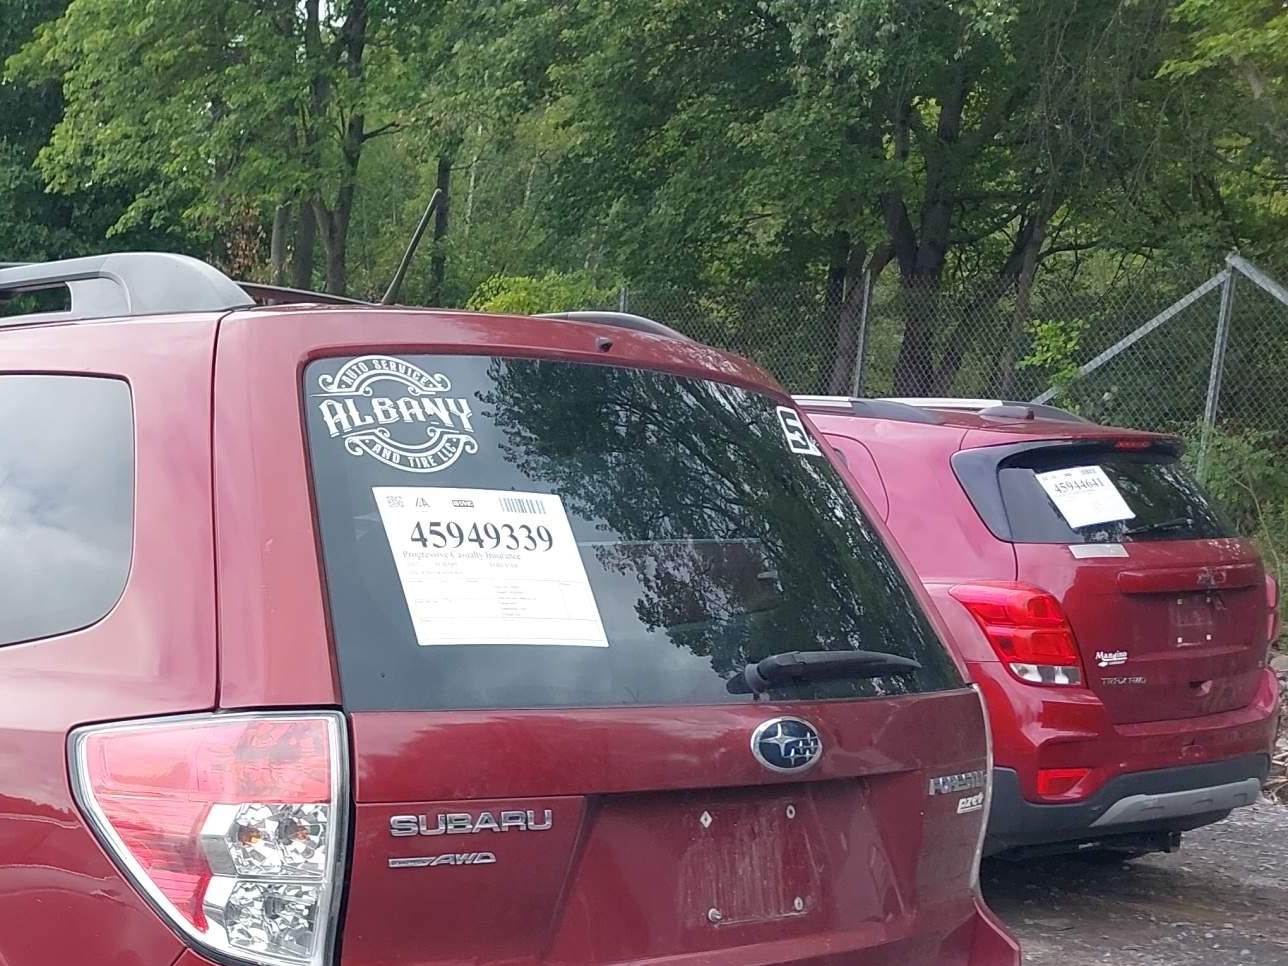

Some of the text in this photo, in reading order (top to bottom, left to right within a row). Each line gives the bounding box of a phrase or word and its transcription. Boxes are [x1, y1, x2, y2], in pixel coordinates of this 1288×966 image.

[344, 359, 429, 385] AUTO SERVICE
[318, 397, 474, 438] ALBANY
[371, 442, 457, 469] AND TIRE LLC
[410, 521, 553, 552] 45949339
[390, 809, 553, 837] SUBARU
[430, 852, 497, 866] AWD
